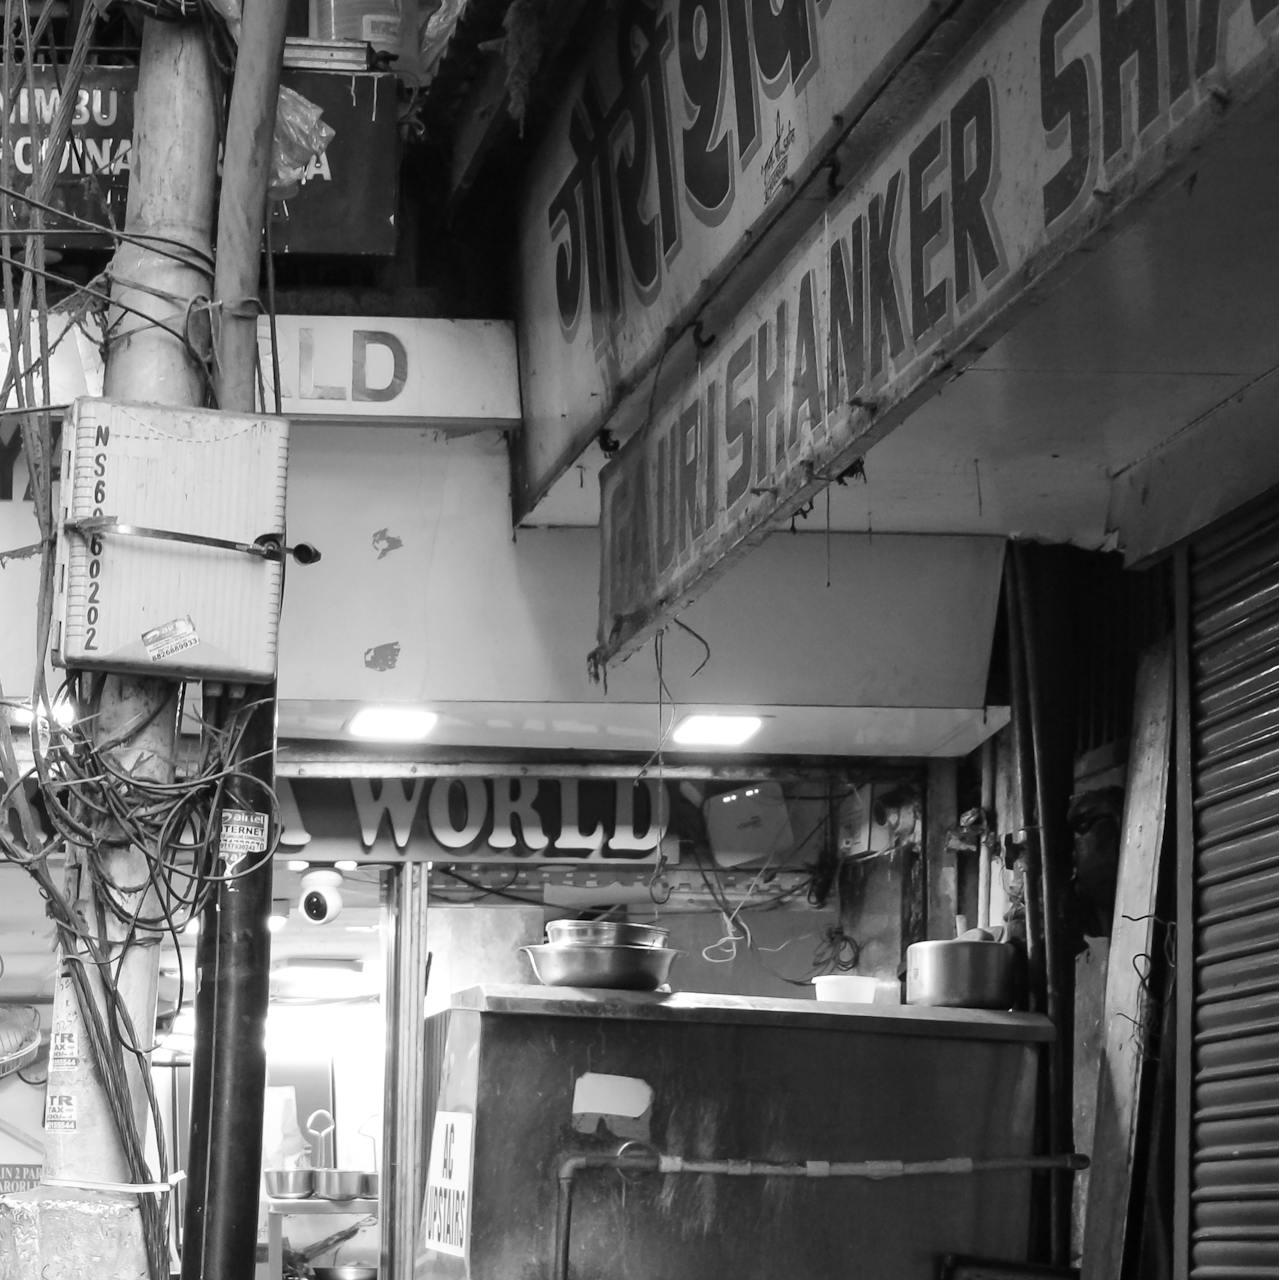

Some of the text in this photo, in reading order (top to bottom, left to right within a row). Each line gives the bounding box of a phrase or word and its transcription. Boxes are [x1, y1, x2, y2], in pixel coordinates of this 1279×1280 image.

[348, 777, 670, 850] WORLD
[442, 1122, 455, 1180] AC
[427, 1185, 465, 1249] UPSTAIRS
